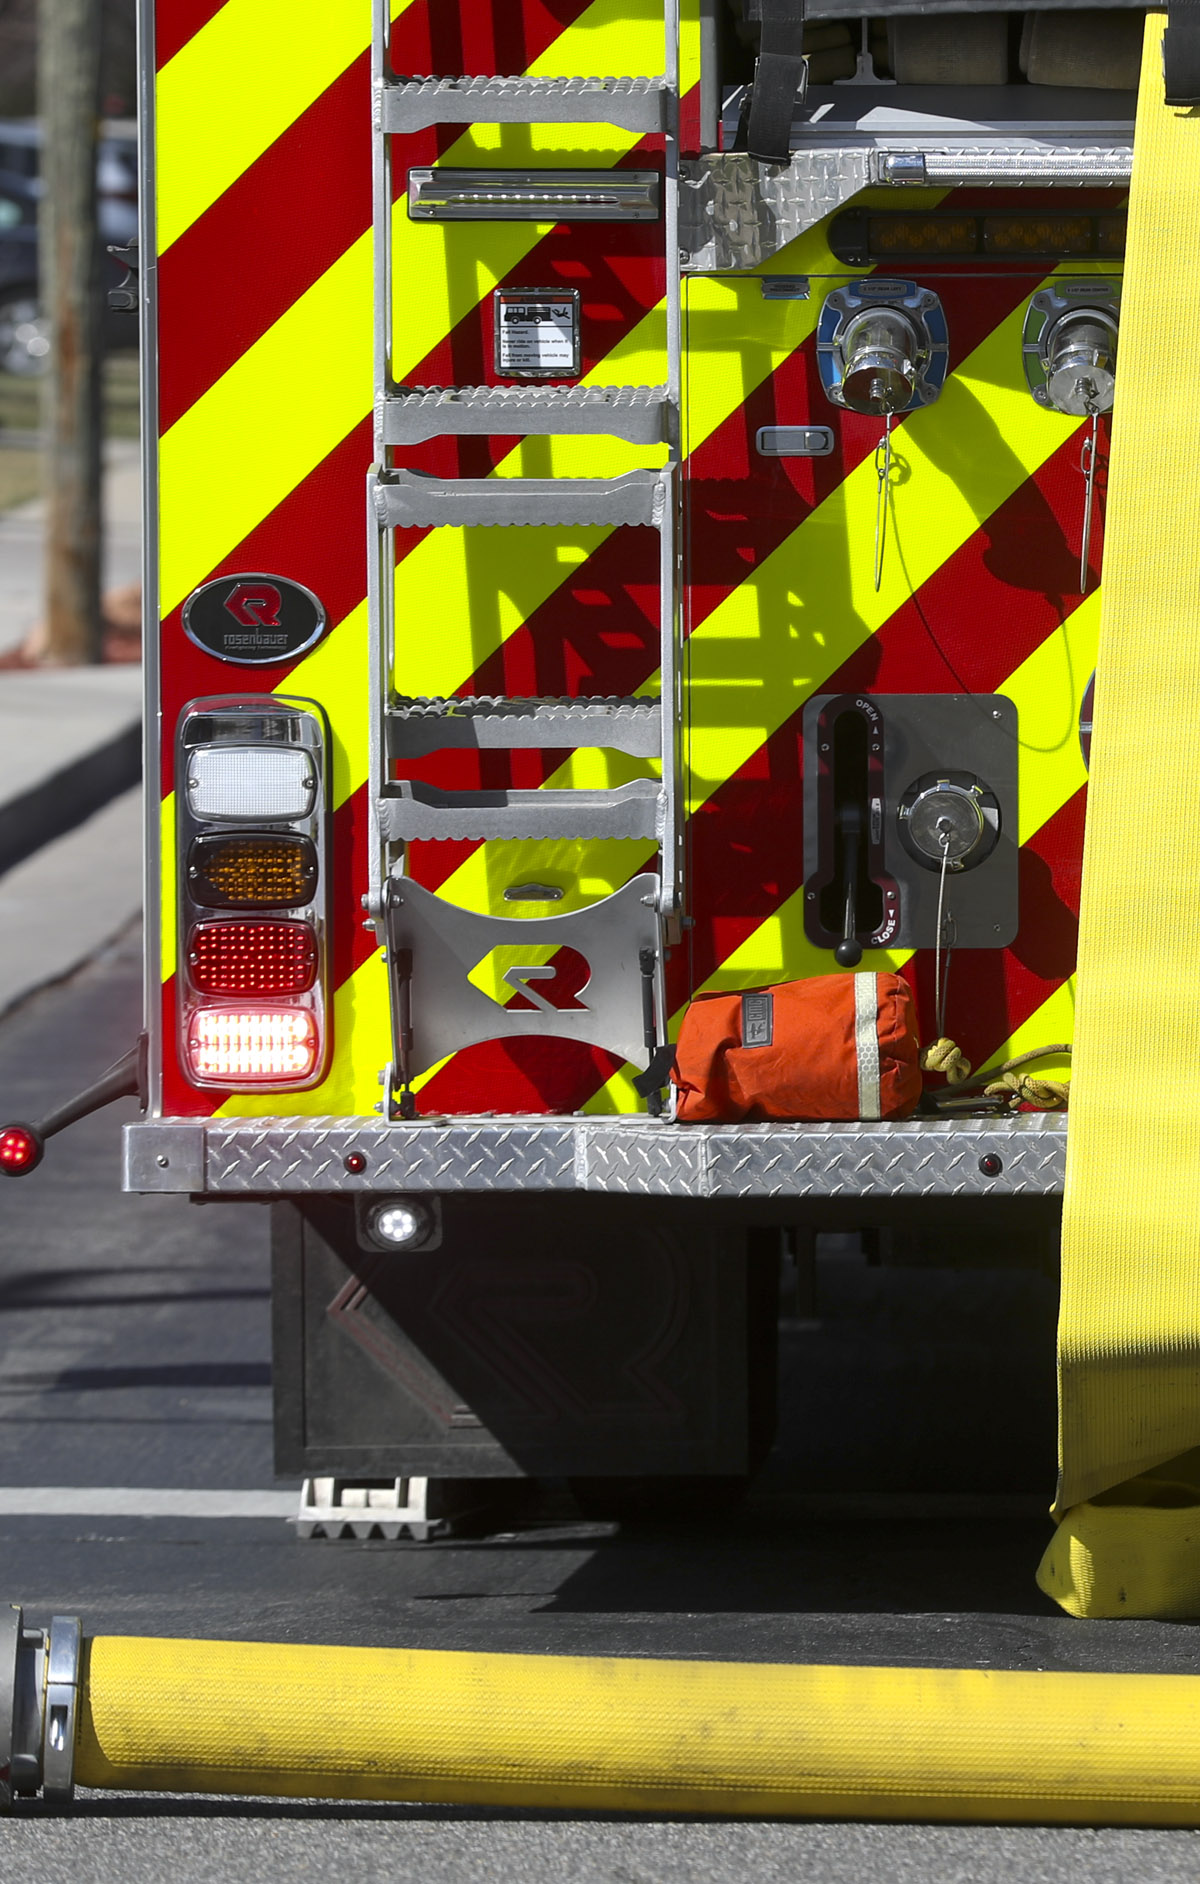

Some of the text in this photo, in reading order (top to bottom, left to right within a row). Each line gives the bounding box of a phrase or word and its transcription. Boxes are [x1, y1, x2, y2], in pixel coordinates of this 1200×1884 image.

[223, 633, 289, 645] rosenbauer
[856, 699, 879, 722] OPEN
[871, 919, 896, 945] CLOSE
